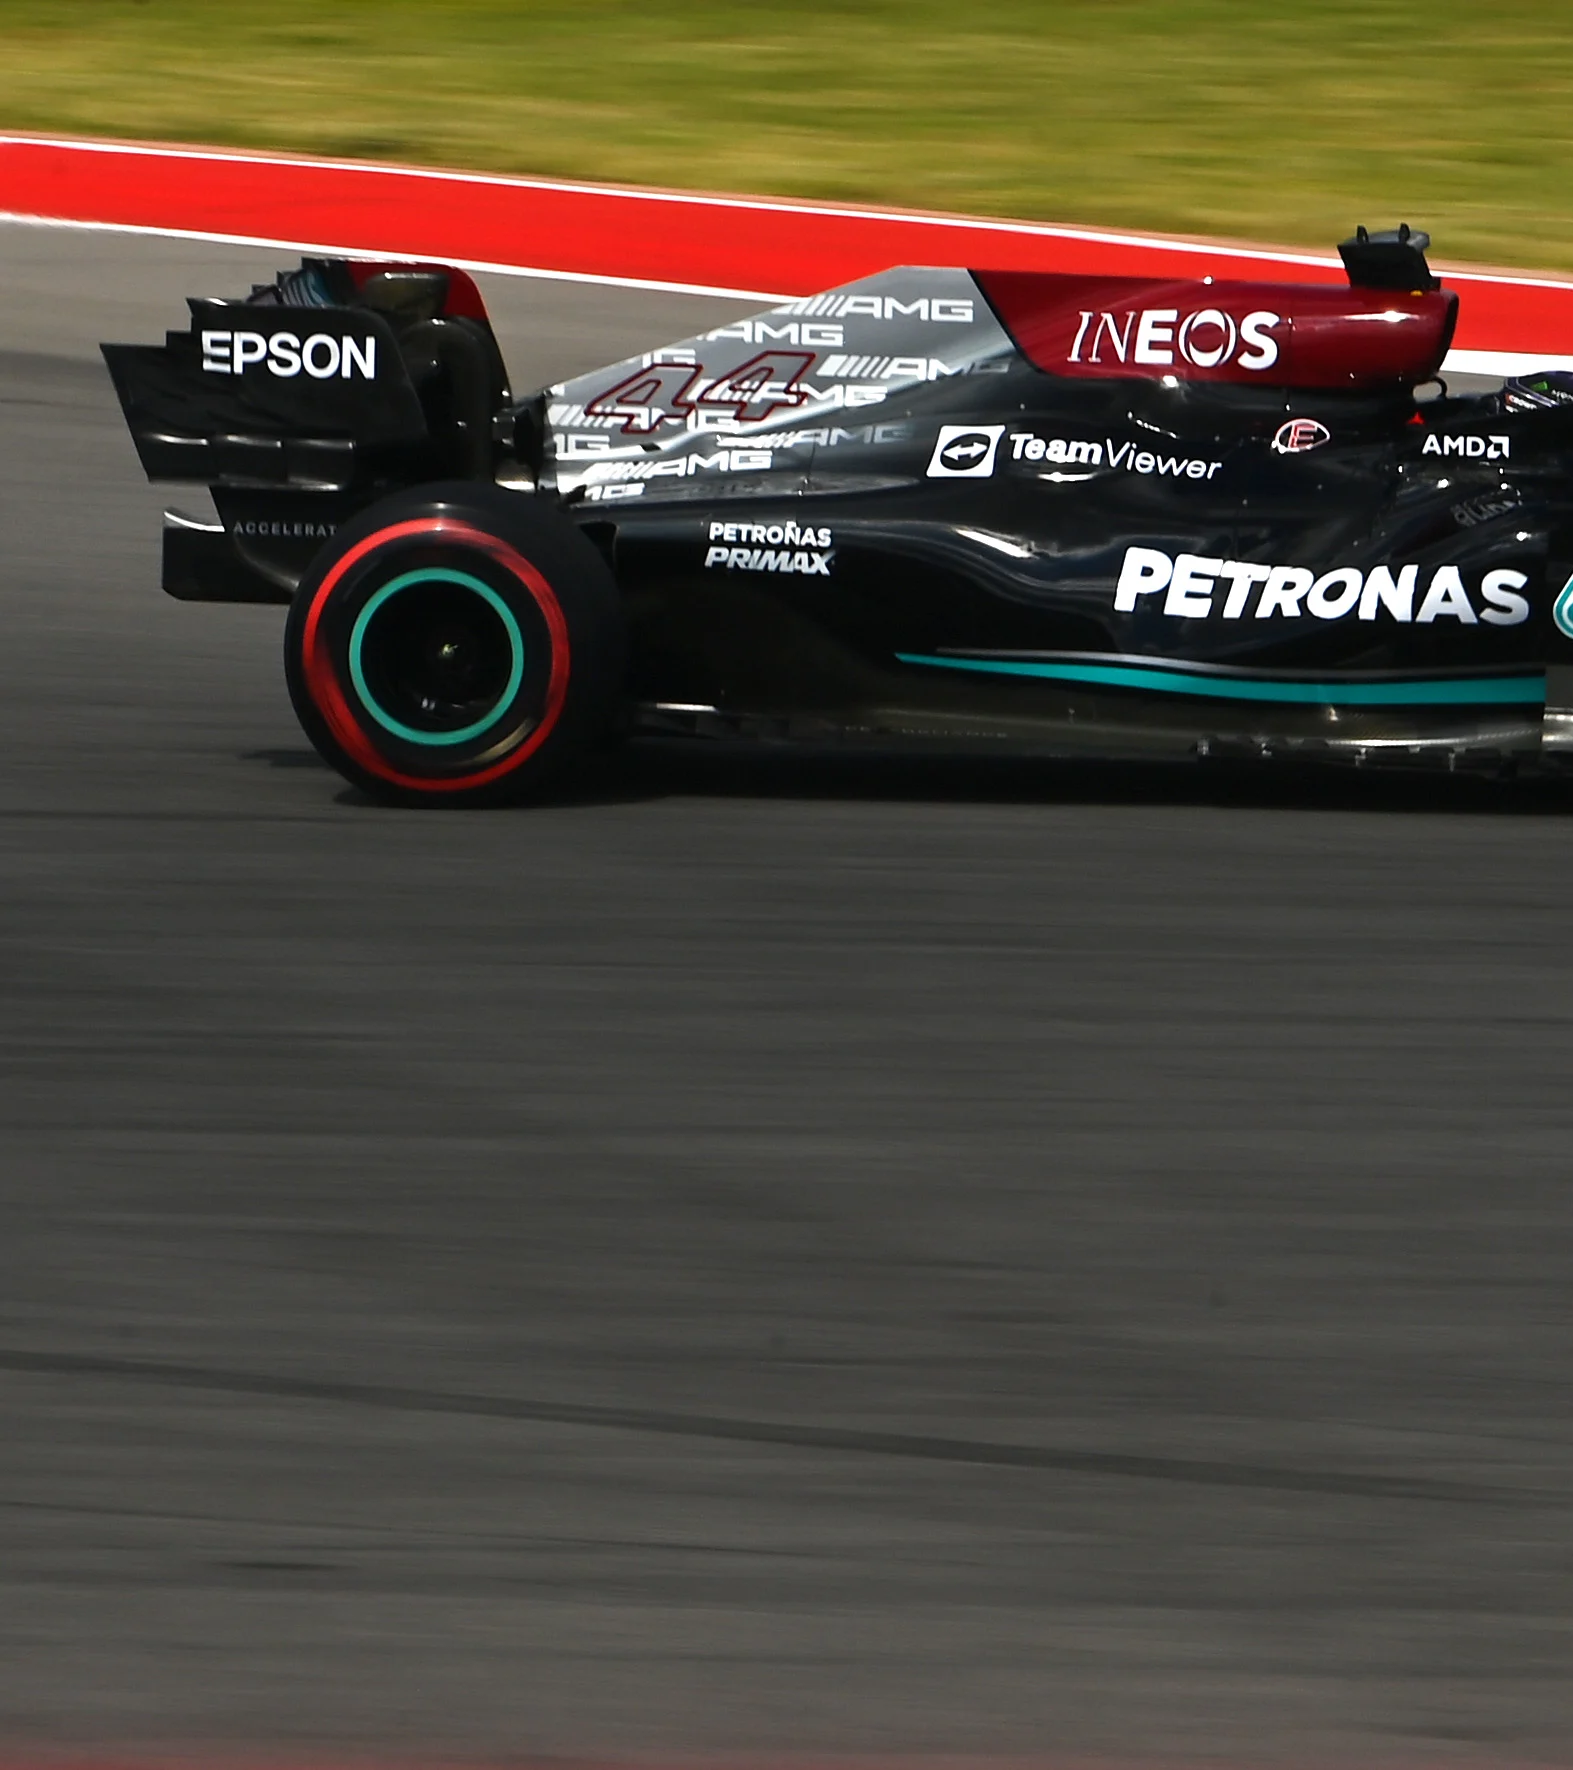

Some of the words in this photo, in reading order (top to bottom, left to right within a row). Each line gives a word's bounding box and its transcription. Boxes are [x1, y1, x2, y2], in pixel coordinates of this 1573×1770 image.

[838, 295, 974, 323] AMG
[706, 321, 844, 347] AMG
[1067, 308, 1280, 370] INEOS
[201, 330, 376, 380] EPSON
[584, 350, 817, 435] 44
[787, 424, 908, 448] AMG
[1422, 434, 1486, 458] AMD
[648, 449, 773, 479] AMG
[1009, 433, 1222, 480] TeamViewer
[709, 521, 832, 547] PETRONAS
[704, 546, 835, 576] PRIMAX
[1113, 546, 1530, 625] PETRONAS
